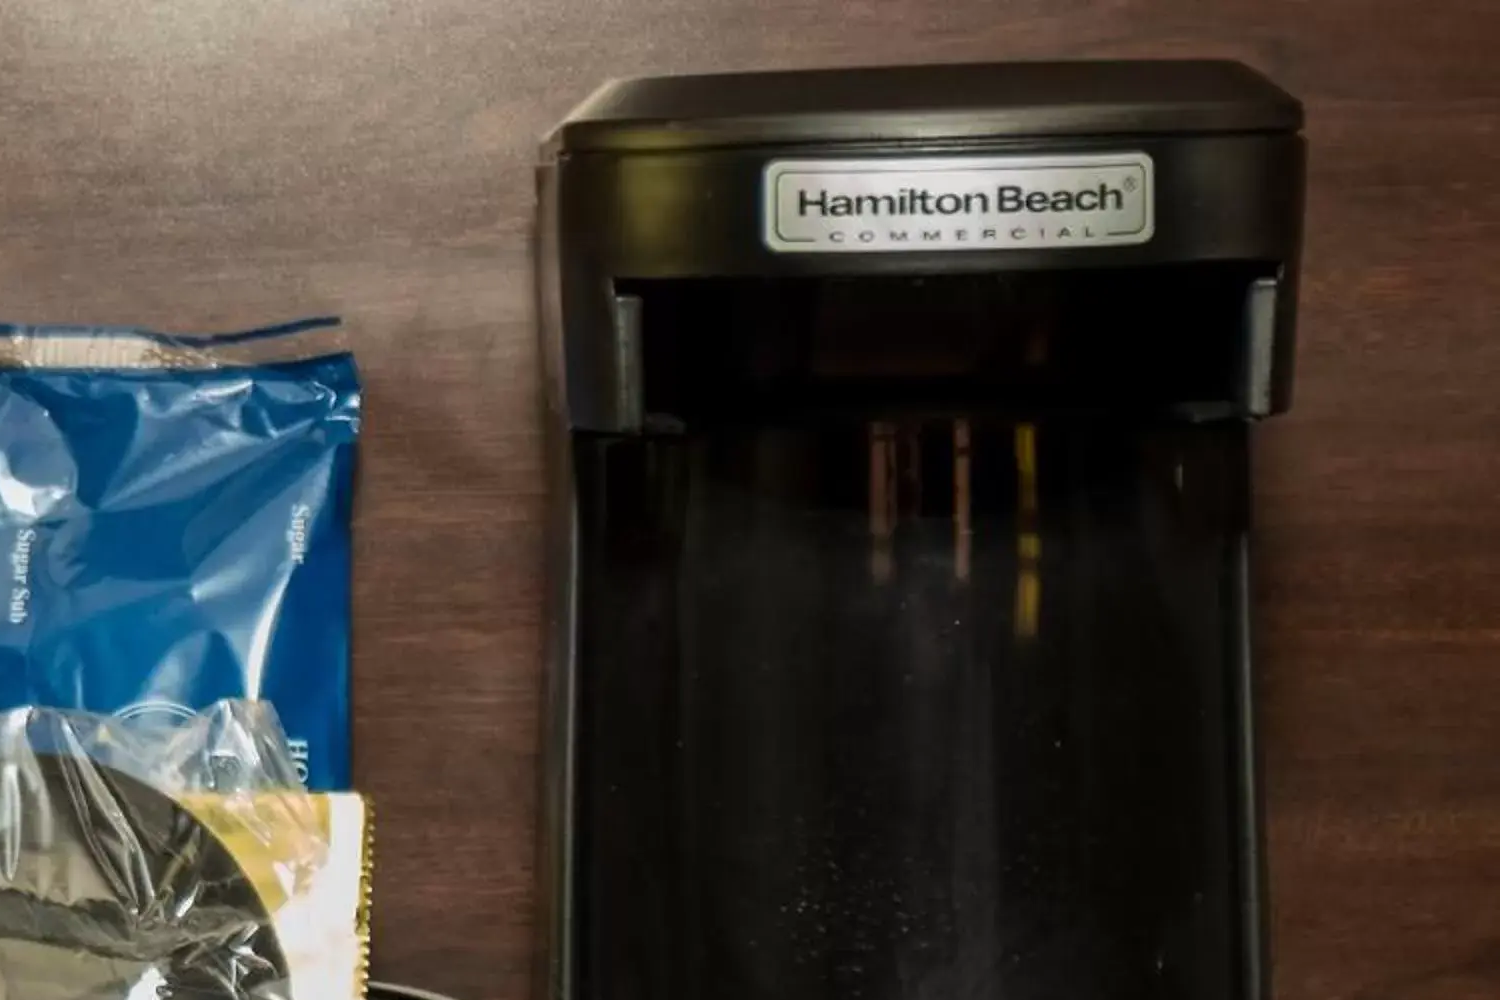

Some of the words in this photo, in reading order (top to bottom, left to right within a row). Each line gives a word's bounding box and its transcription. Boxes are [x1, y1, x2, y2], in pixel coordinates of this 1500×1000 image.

[798, 187, 989, 216] Hamilton
[997, 182, 1124, 213] Beach
[828, 226, 1096, 243] COMMERCIAL
[285, 503, 311, 565] Sugar
[9, 528, 37, 585] Sugar
[9, 587, 31, 624] Sub
